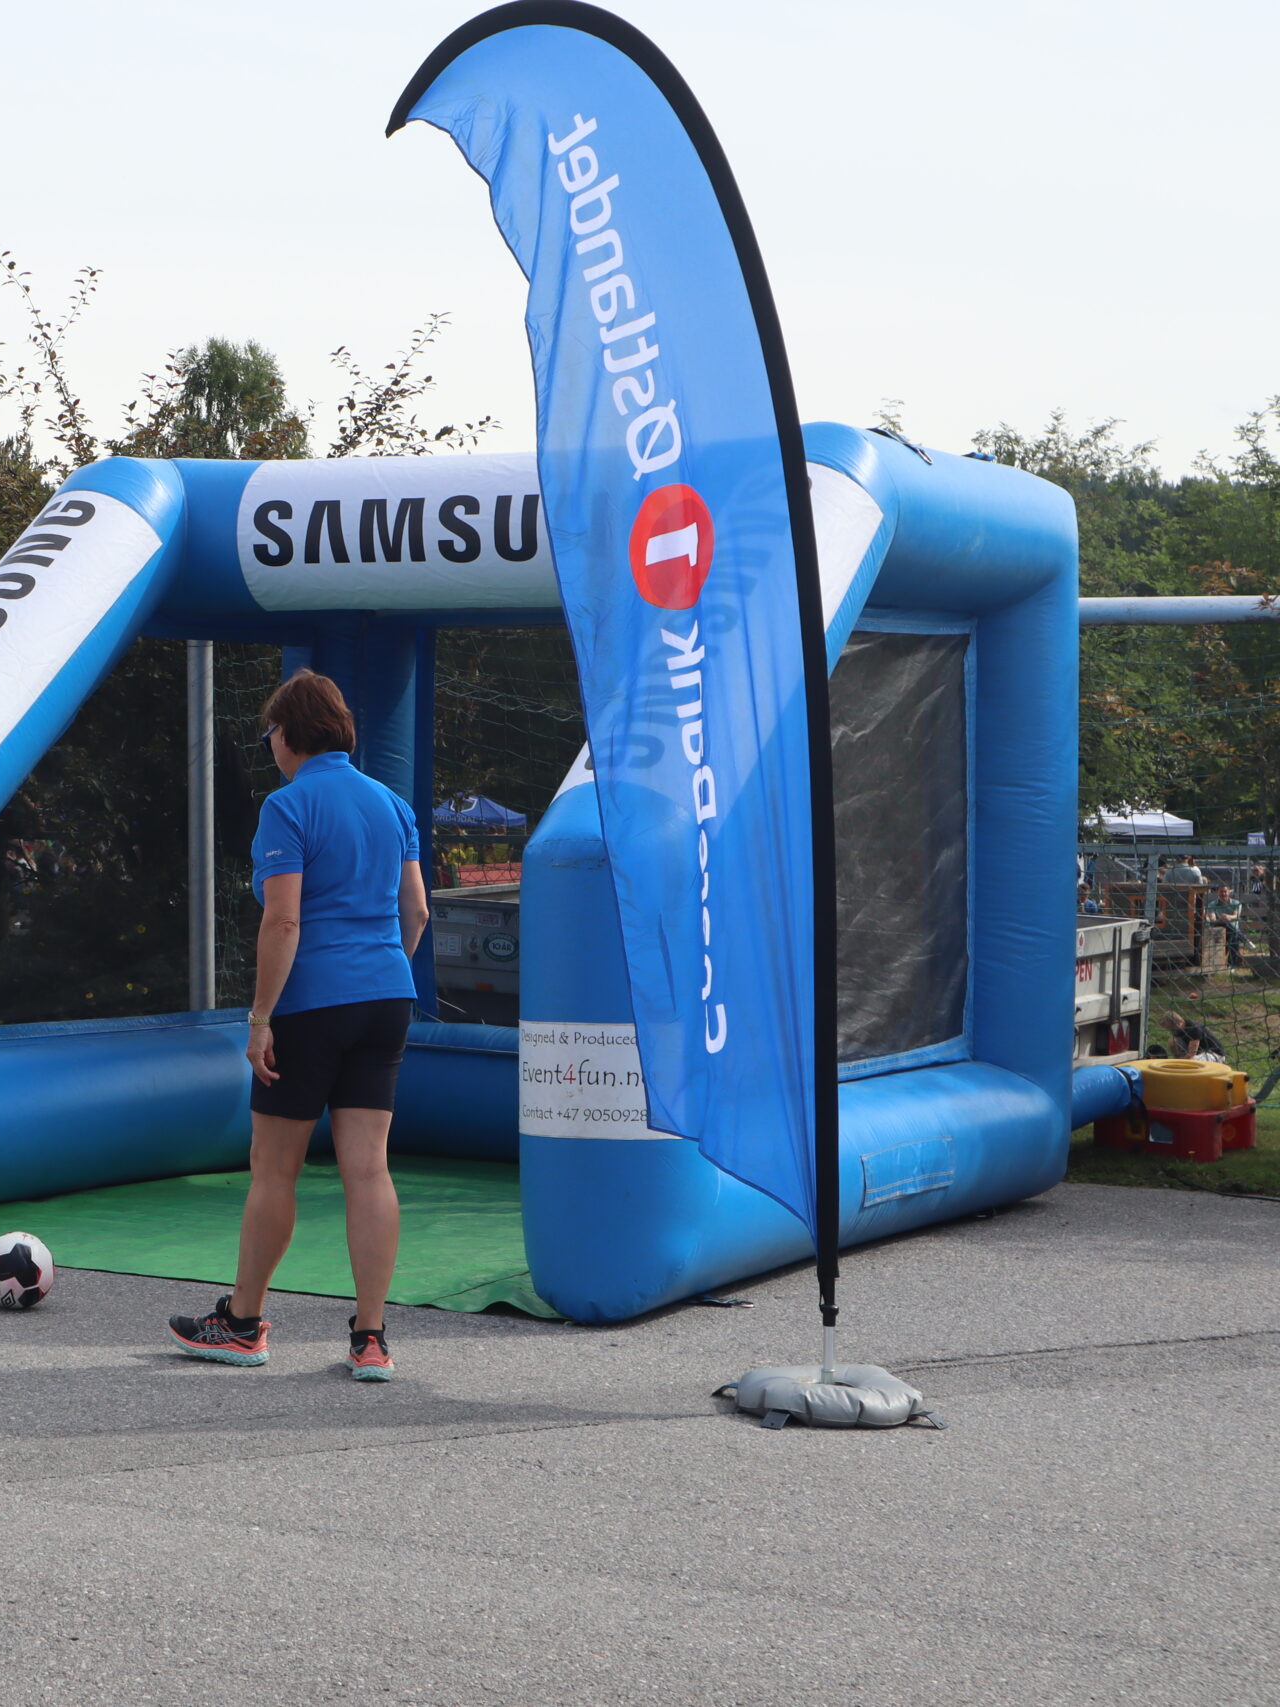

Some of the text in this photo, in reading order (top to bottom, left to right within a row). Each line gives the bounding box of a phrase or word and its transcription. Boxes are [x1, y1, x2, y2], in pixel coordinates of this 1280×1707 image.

[253, 494, 542, 568] SAMSU
[560, 1032, 569, 1045] &
[522, 1058, 644, 1087] Event4fun.n
[522, 1104, 648, 1122] Contact +47 9050928
